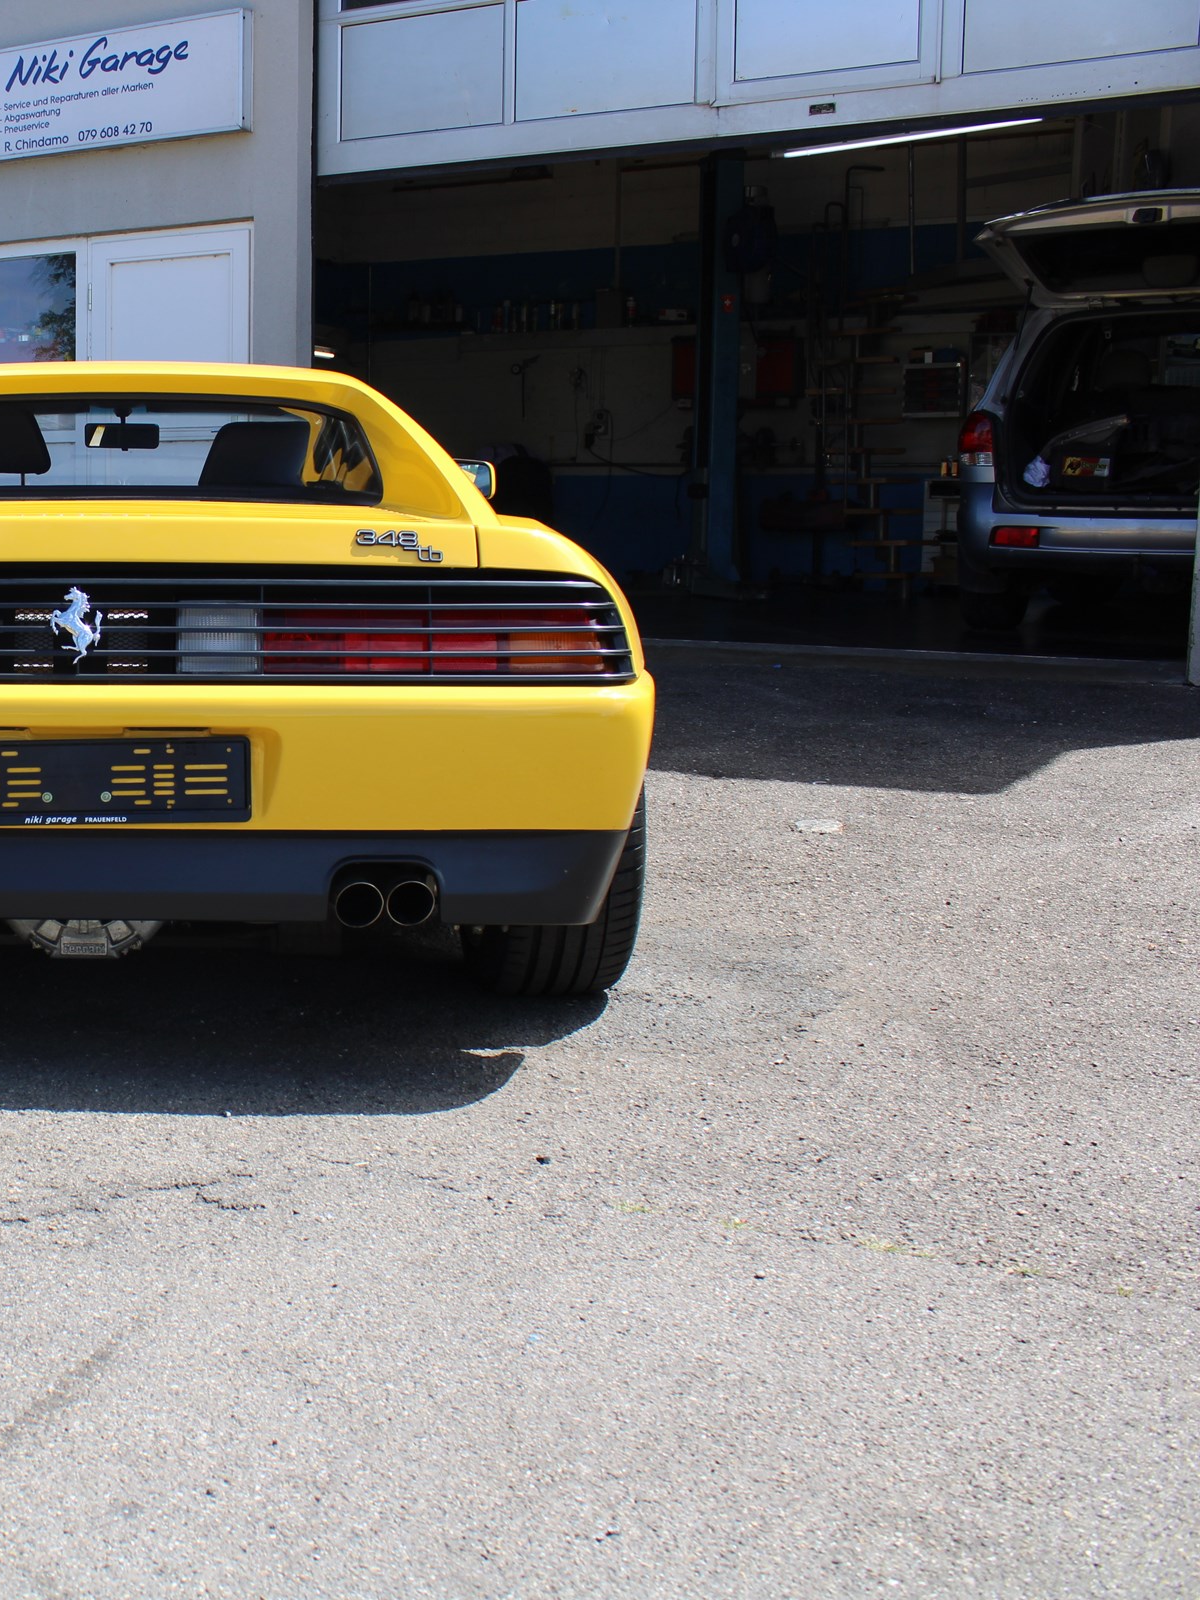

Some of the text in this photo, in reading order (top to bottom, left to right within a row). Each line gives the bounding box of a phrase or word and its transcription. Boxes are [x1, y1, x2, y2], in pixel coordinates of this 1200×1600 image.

[5, 36, 189, 92] Niki Garage
[3, 82, 154, 112] Service und Reparaturen aller Marken
[4, 108, 61, 123] Abgaswartung
[4, 121, 50, 134] Pneuservice
[4, 121, 153, 152] R. Chindamo 079 608 42 70
[356, 529, 443, 562] 348 tb
[24, 815, 44, 825] niki
[45, 816, 78, 825] garage
